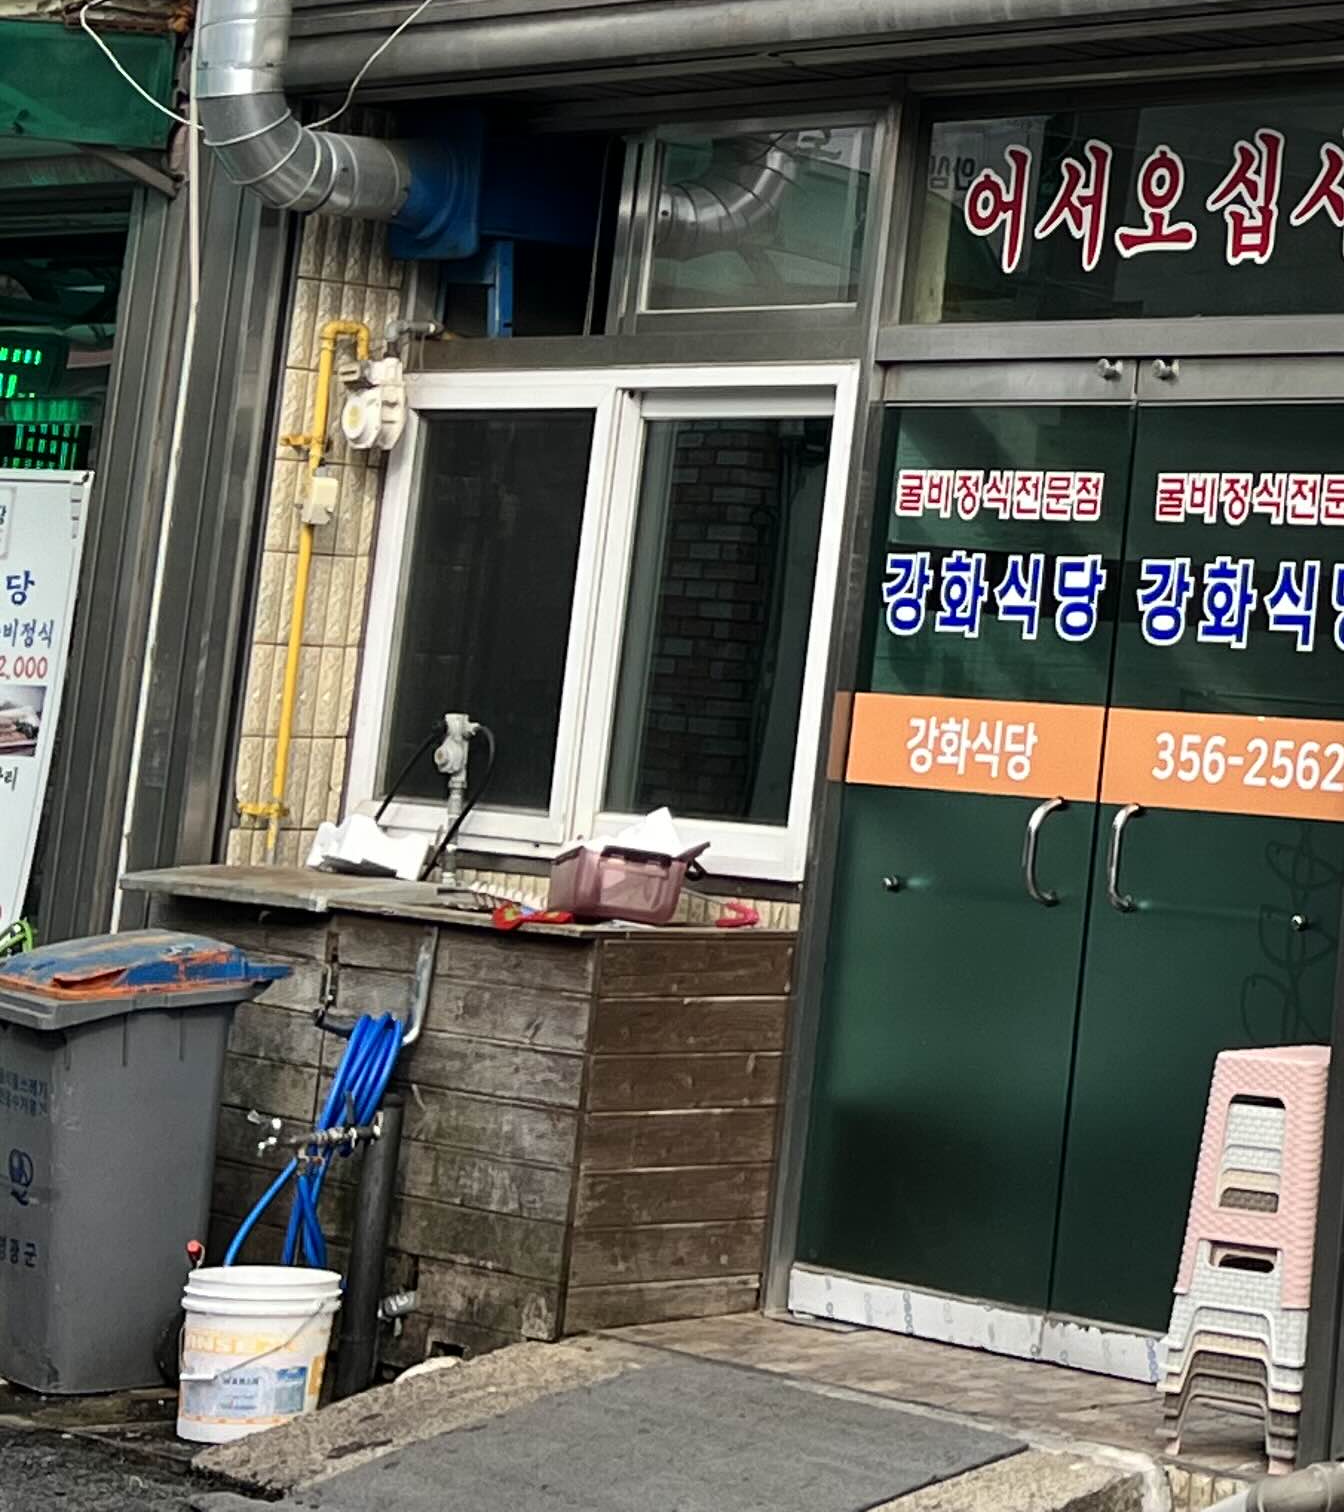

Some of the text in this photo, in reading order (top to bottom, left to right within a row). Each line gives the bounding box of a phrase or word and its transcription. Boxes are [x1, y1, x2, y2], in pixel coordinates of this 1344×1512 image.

[895, 470, 1105, 521] 굴비정식전문점
[882, 550, 1106, 642] 강화식당
[0, 618, 55, 649] 비정식
[905, 716, 1039, 782] 강화식당
